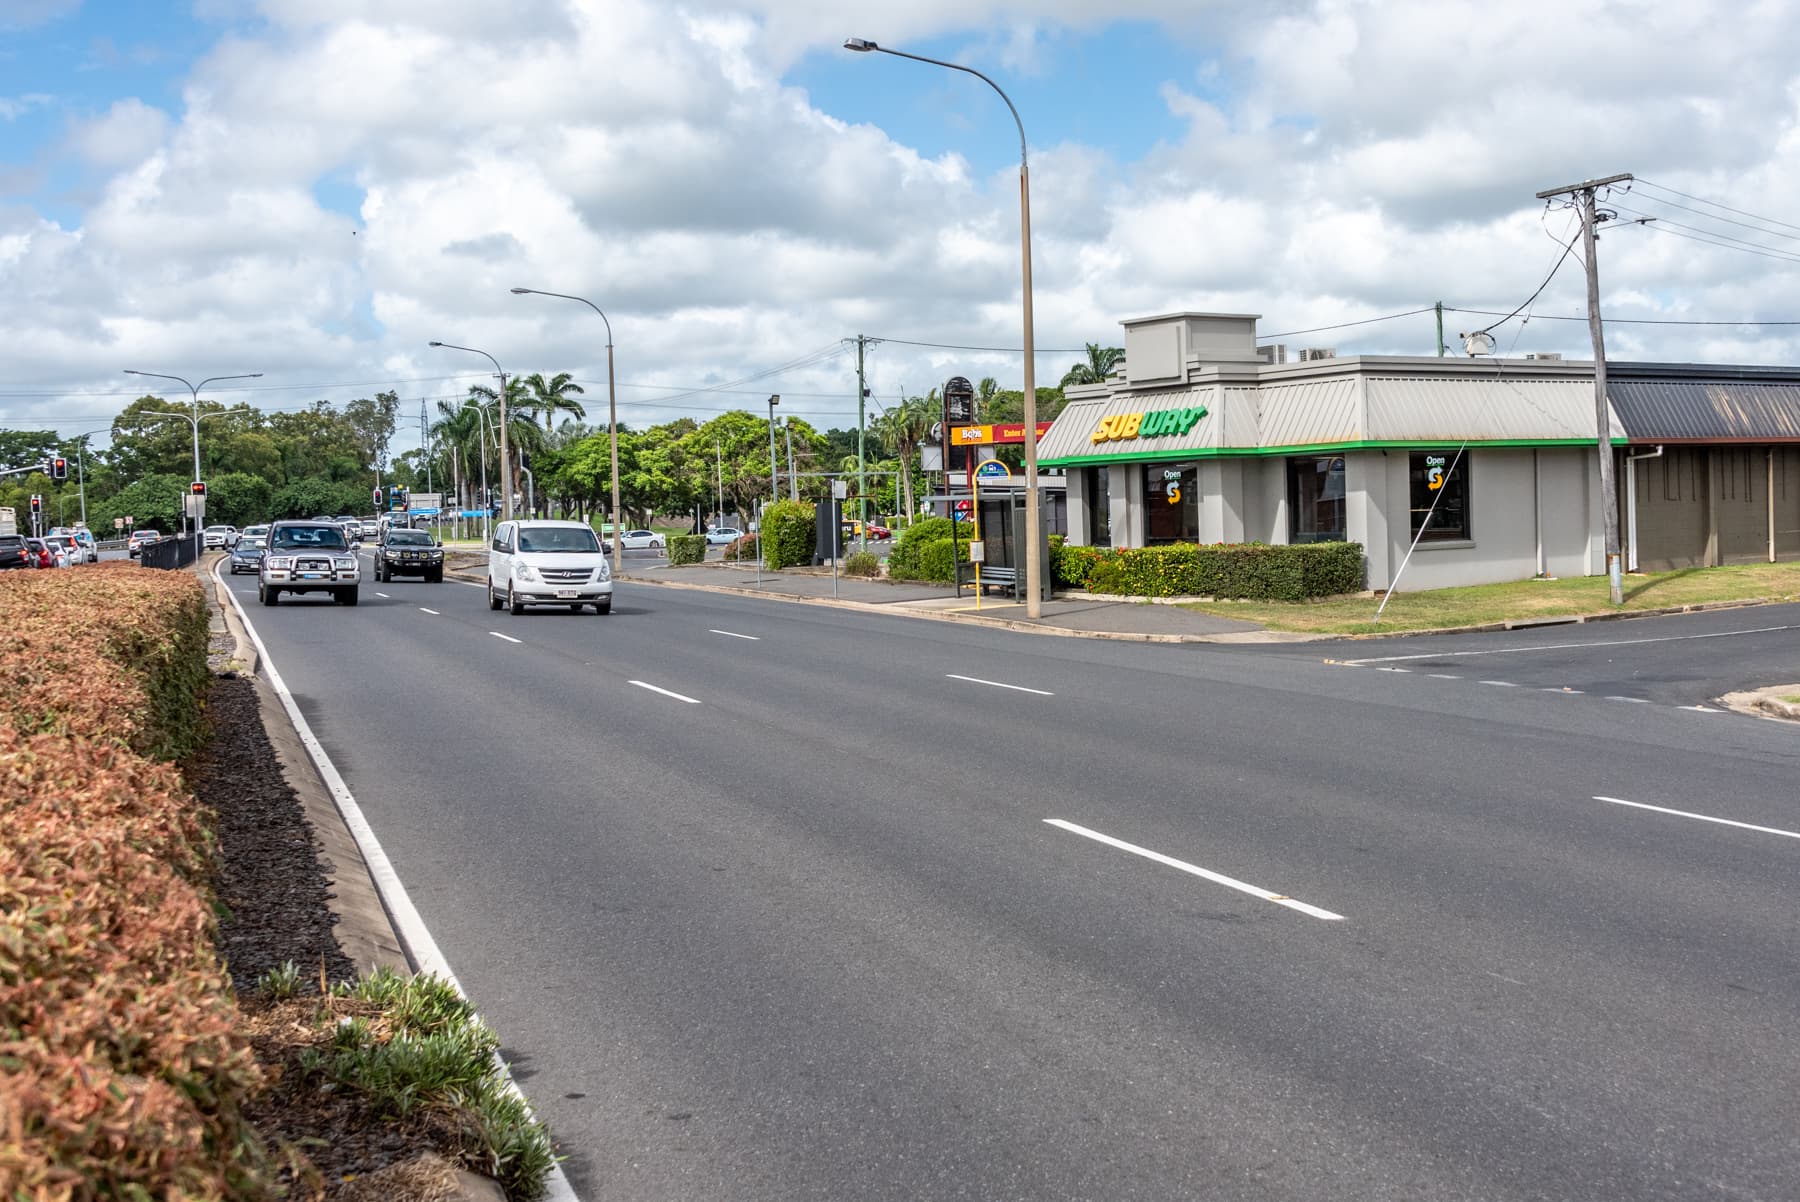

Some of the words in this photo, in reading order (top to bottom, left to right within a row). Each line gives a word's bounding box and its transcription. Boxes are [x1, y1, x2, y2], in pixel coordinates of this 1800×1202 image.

[1091, 405, 1208, 446] SUBWAY
[1426, 455, 1445, 466] Open
[1164, 470, 1182, 480] Open
